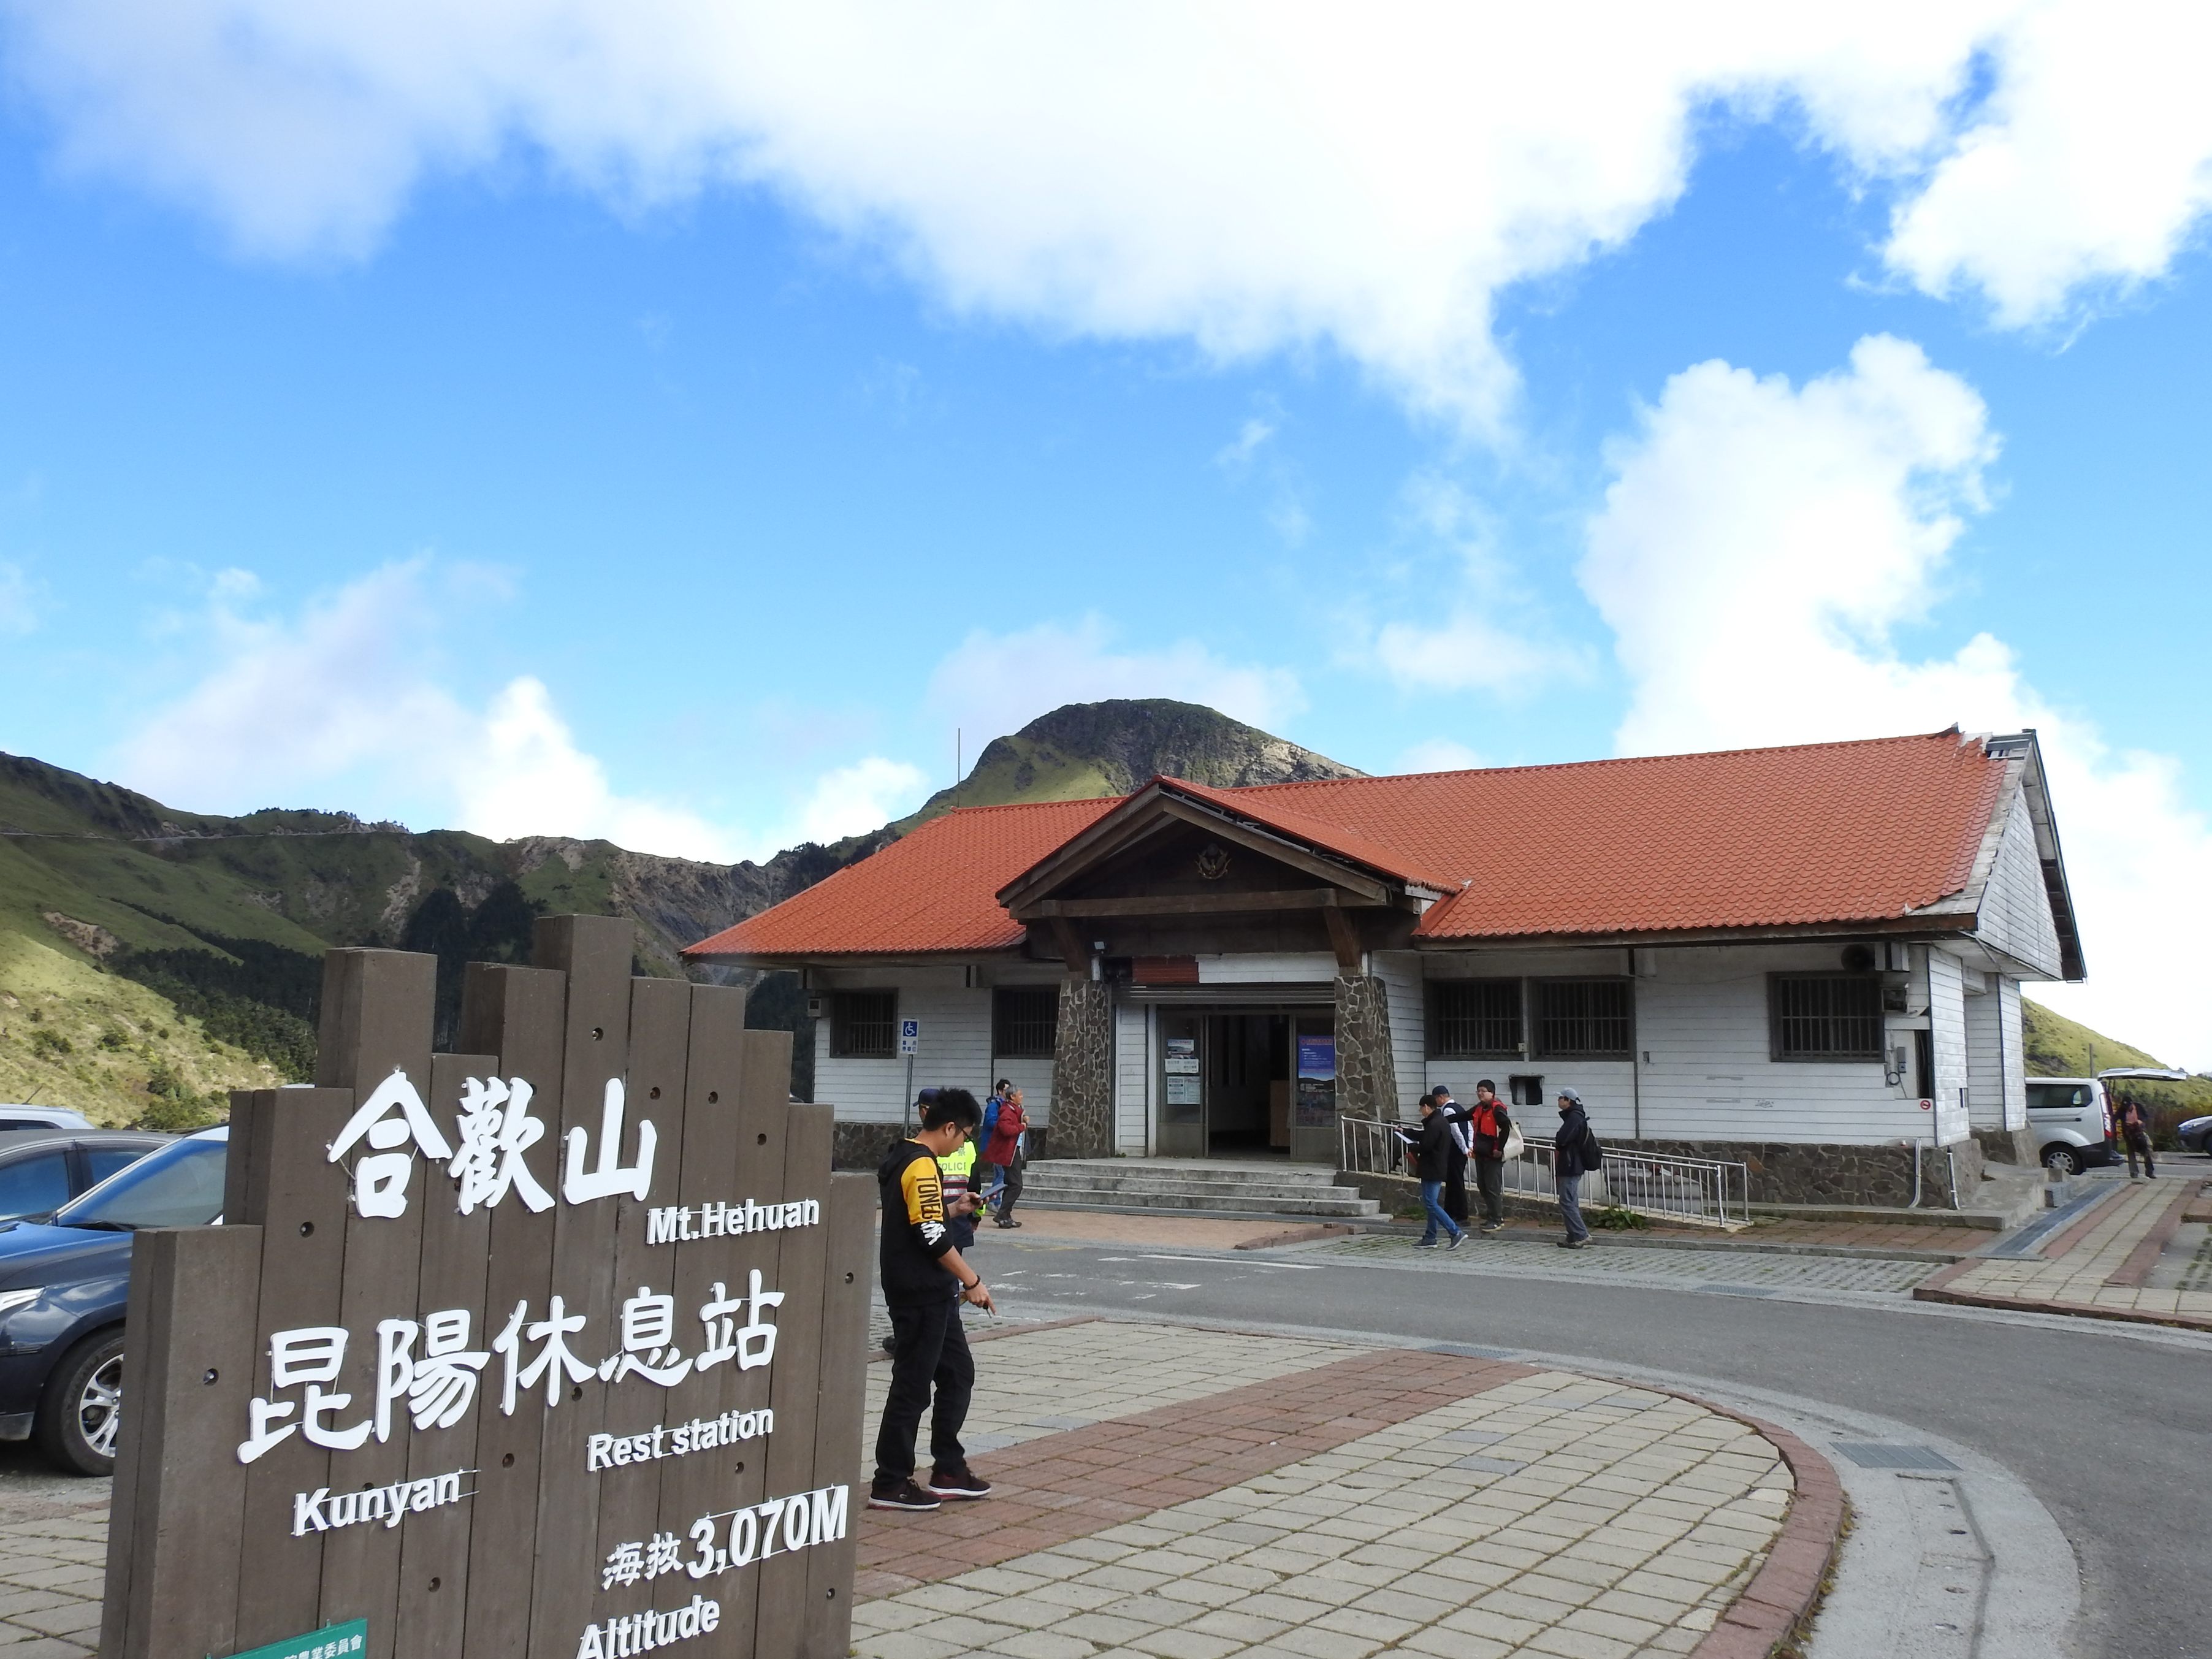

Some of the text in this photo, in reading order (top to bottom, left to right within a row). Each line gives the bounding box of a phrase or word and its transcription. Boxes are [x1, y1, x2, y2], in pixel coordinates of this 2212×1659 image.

[327, 1070, 657, 1219] 合歡山
[647, 1199, 819, 1245] Mt.Hehuan
[237, 1269, 785, 1463] 昆陽休息站
[587, 1409, 774, 1471] Rest station
[293, 1470, 460, 1536] Kunyan
[686, 1484, 849, 1579] 3,070M
[576, 1595, 720, 1659] Altitude
